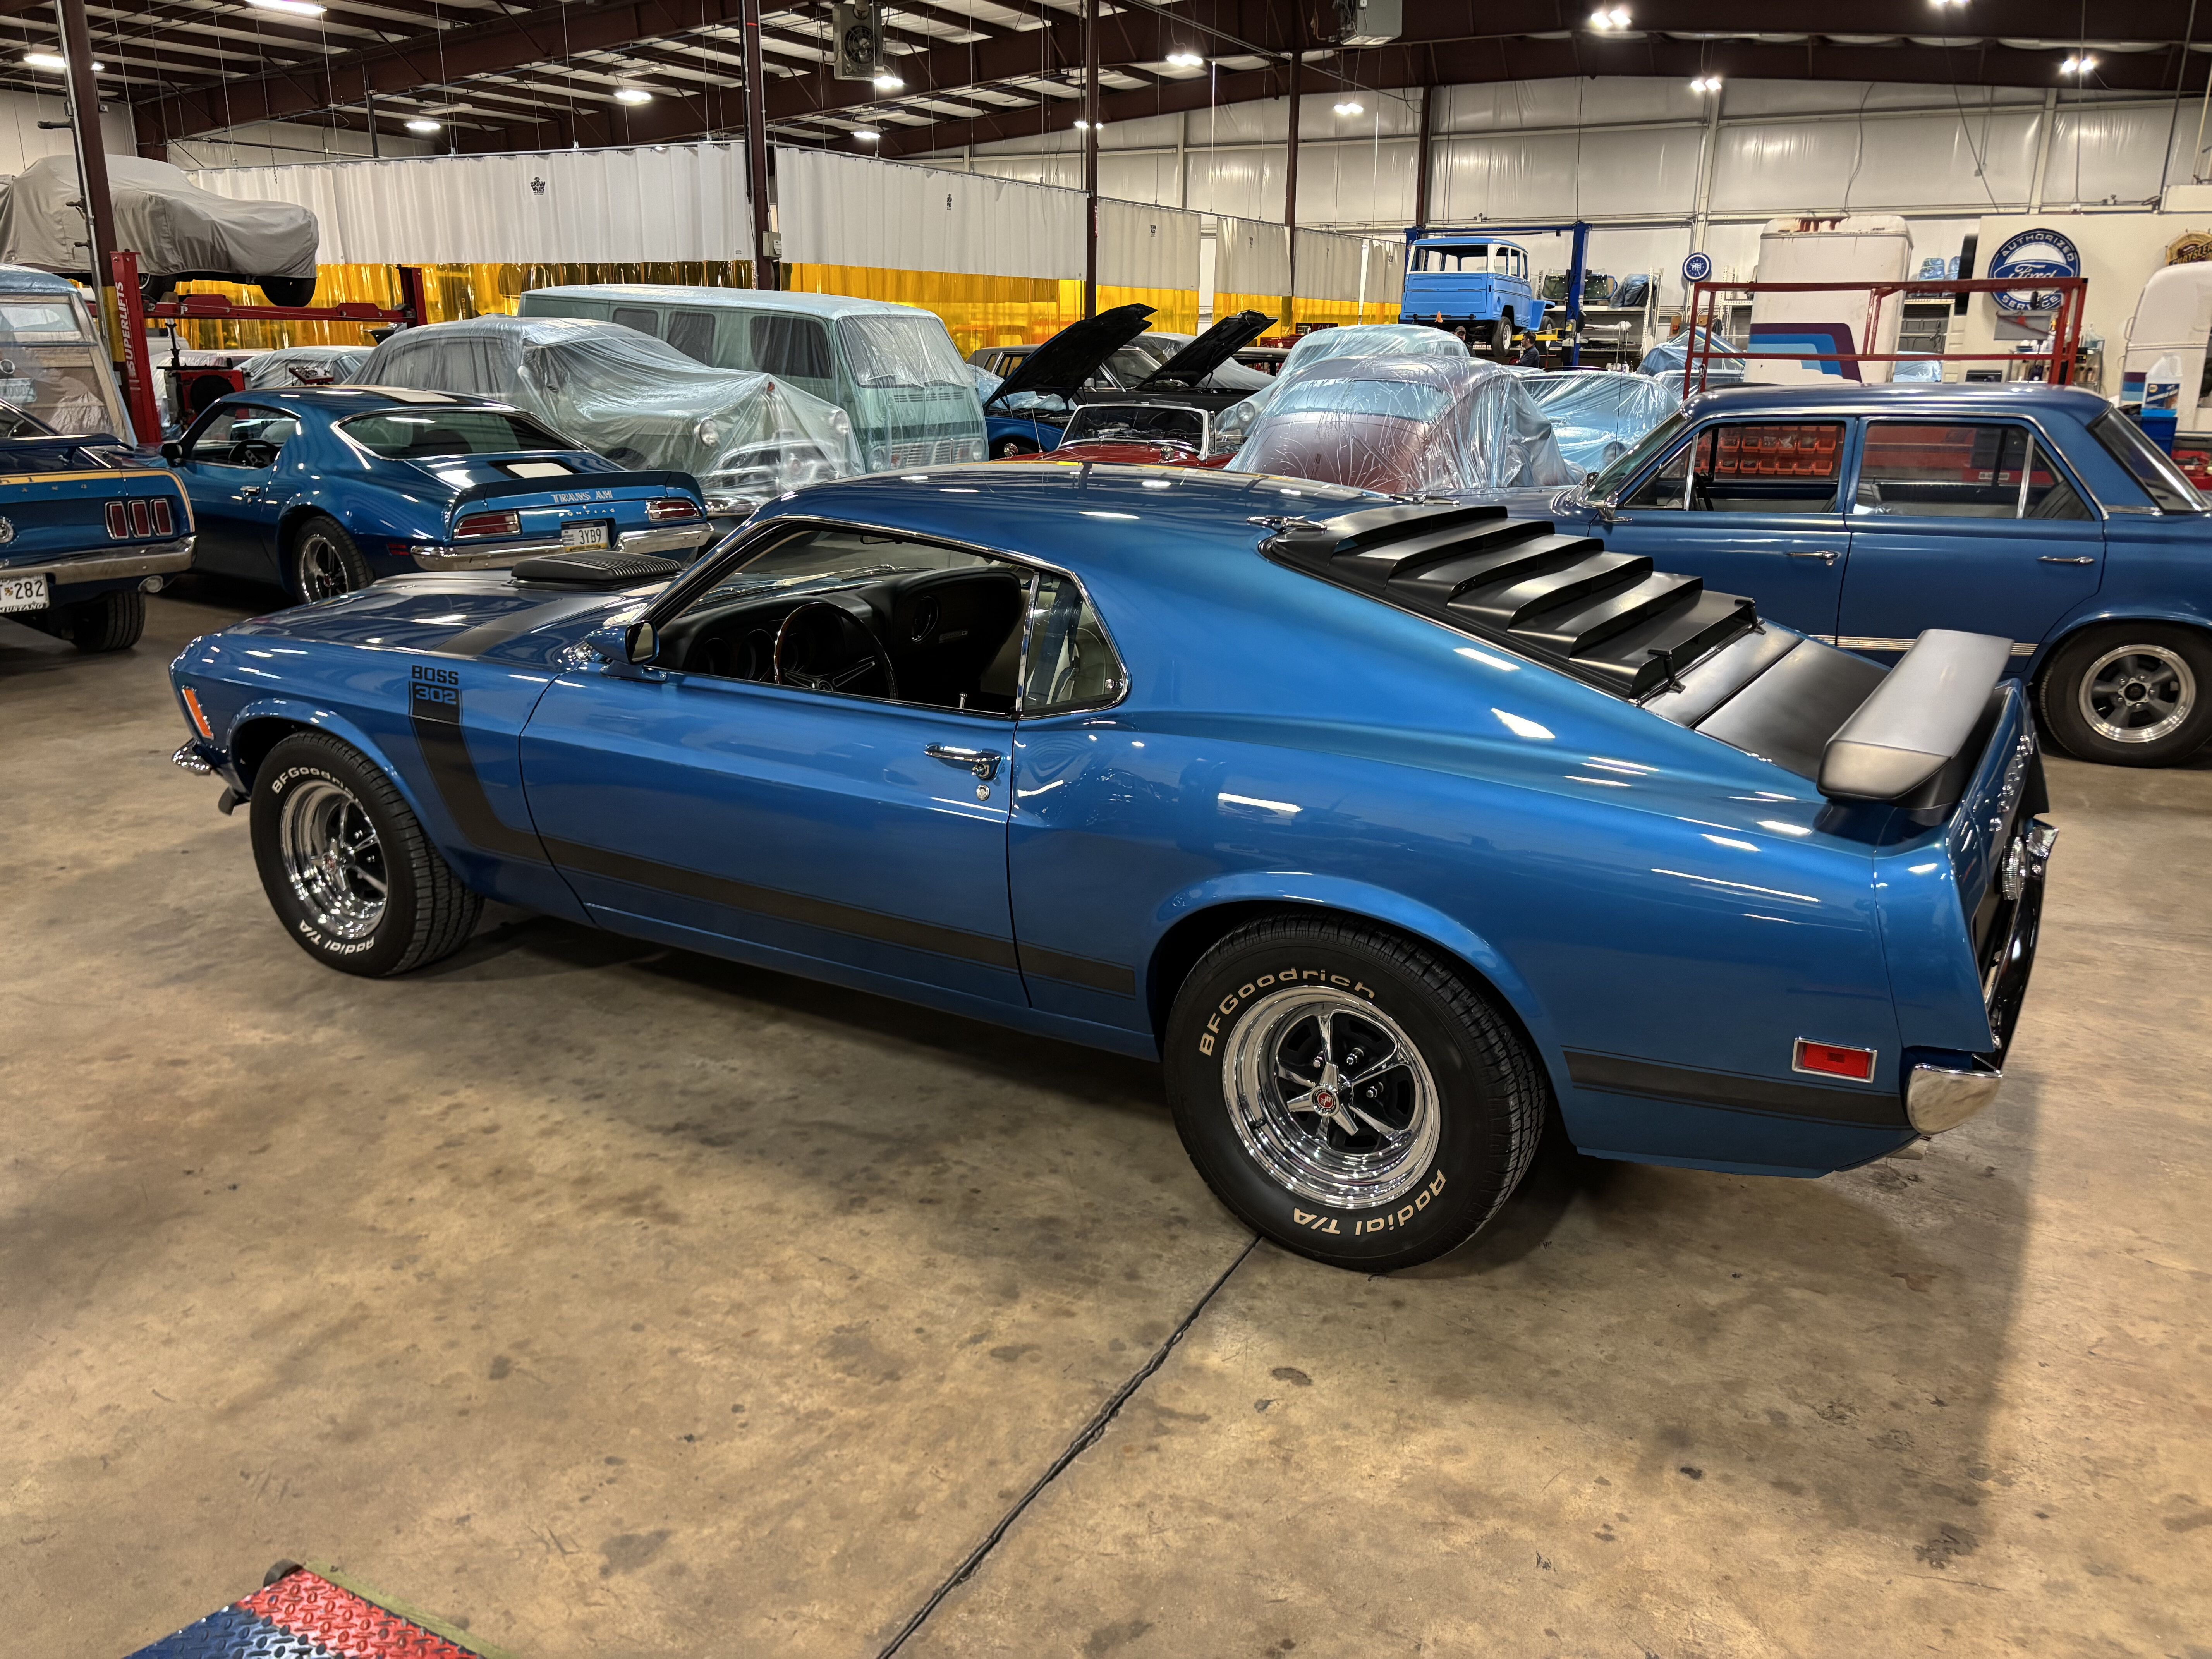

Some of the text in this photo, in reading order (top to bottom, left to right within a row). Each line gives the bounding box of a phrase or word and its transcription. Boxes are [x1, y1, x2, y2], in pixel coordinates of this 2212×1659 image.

[2001, 233, 2075, 262] AUTHORIZED
[2001, 293, 2061, 310] SERVCE
[115, 282, 136, 371] SUPERLIFTS
[551, 490, 613, 503] TRANS AM
[558, 508, 615, 517] PONTIAC
[579, 528, 601, 544] 3YB9
[412, 665, 459, 685] BOSS
[416, 685, 457, 705] 302
[299, 919, 374, 955] Radial T/A
[1199, 967, 1376, 1056] BFGoodrich
[1293, 1169, 1447, 1236] Radial T/A
